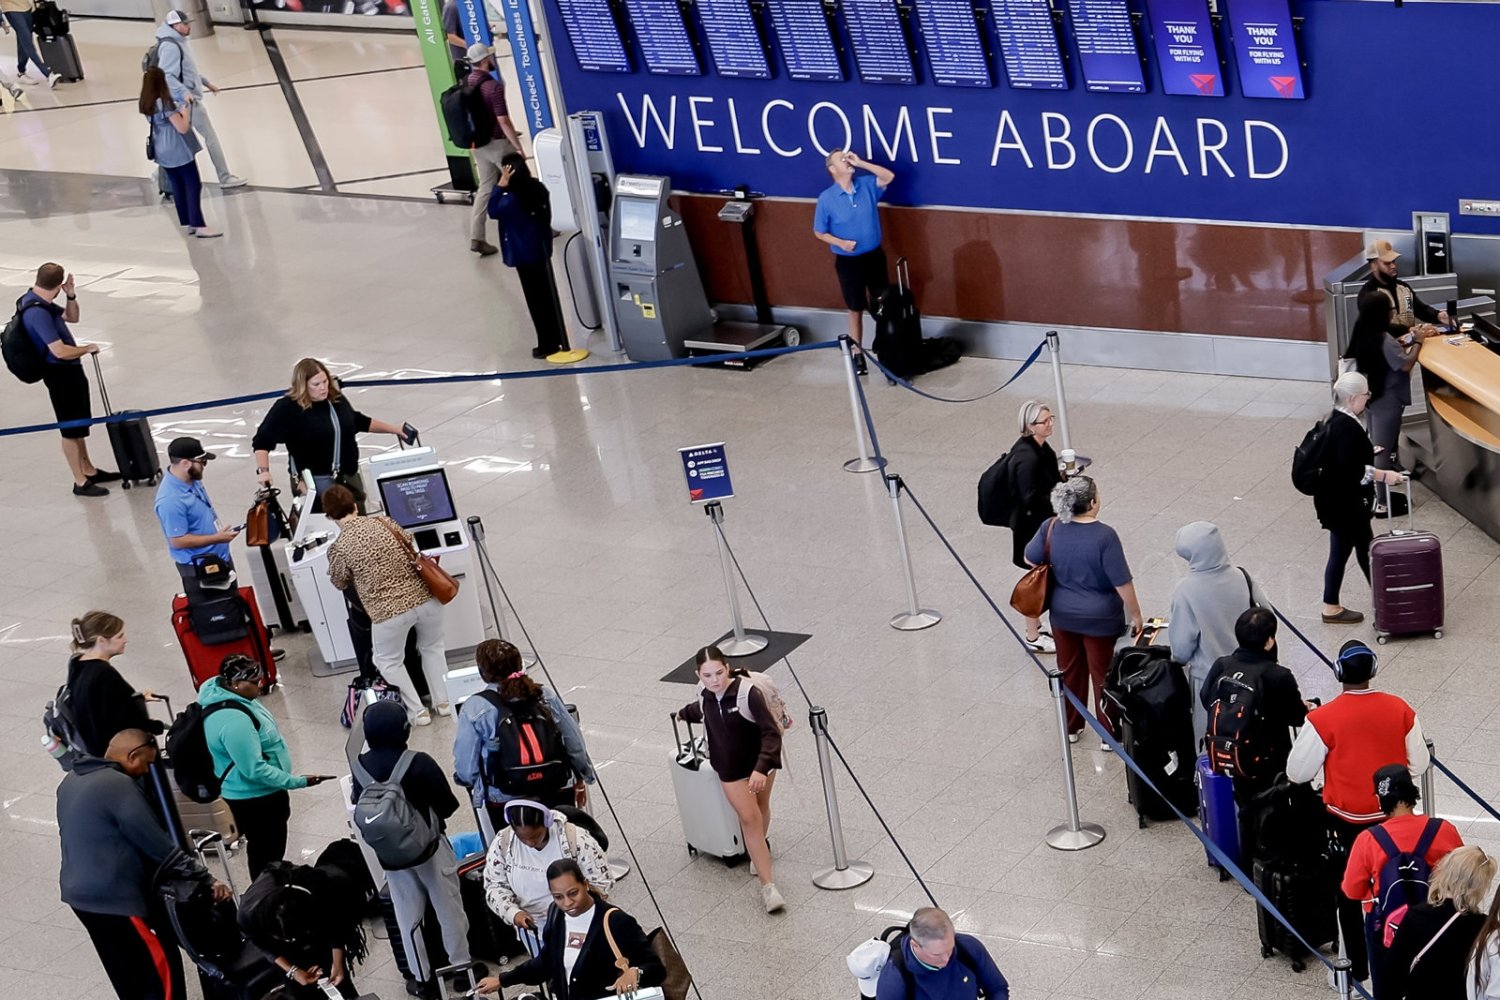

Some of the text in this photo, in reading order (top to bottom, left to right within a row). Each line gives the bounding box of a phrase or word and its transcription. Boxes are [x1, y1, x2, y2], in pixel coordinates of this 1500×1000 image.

[1166, 25, 1197, 35] THANK
[1246, 27, 1278, 36] THANK
[424, 29, 436, 44] All
[513, 12, 531, 68] Touchless
[1173, 35, 1193, 43] YOU
[1253, 37, 1273, 45] YOU
[1182, 49, 1204, 57] FLYING
[1262, 51, 1285, 59] FLYING
[1173, 55, 1191, 63] WITH
[1253, 57, 1271, 65] WITH
[616, 92, 961, 165] WELCOME
[990, 110, 1289, 180] ABOARD
